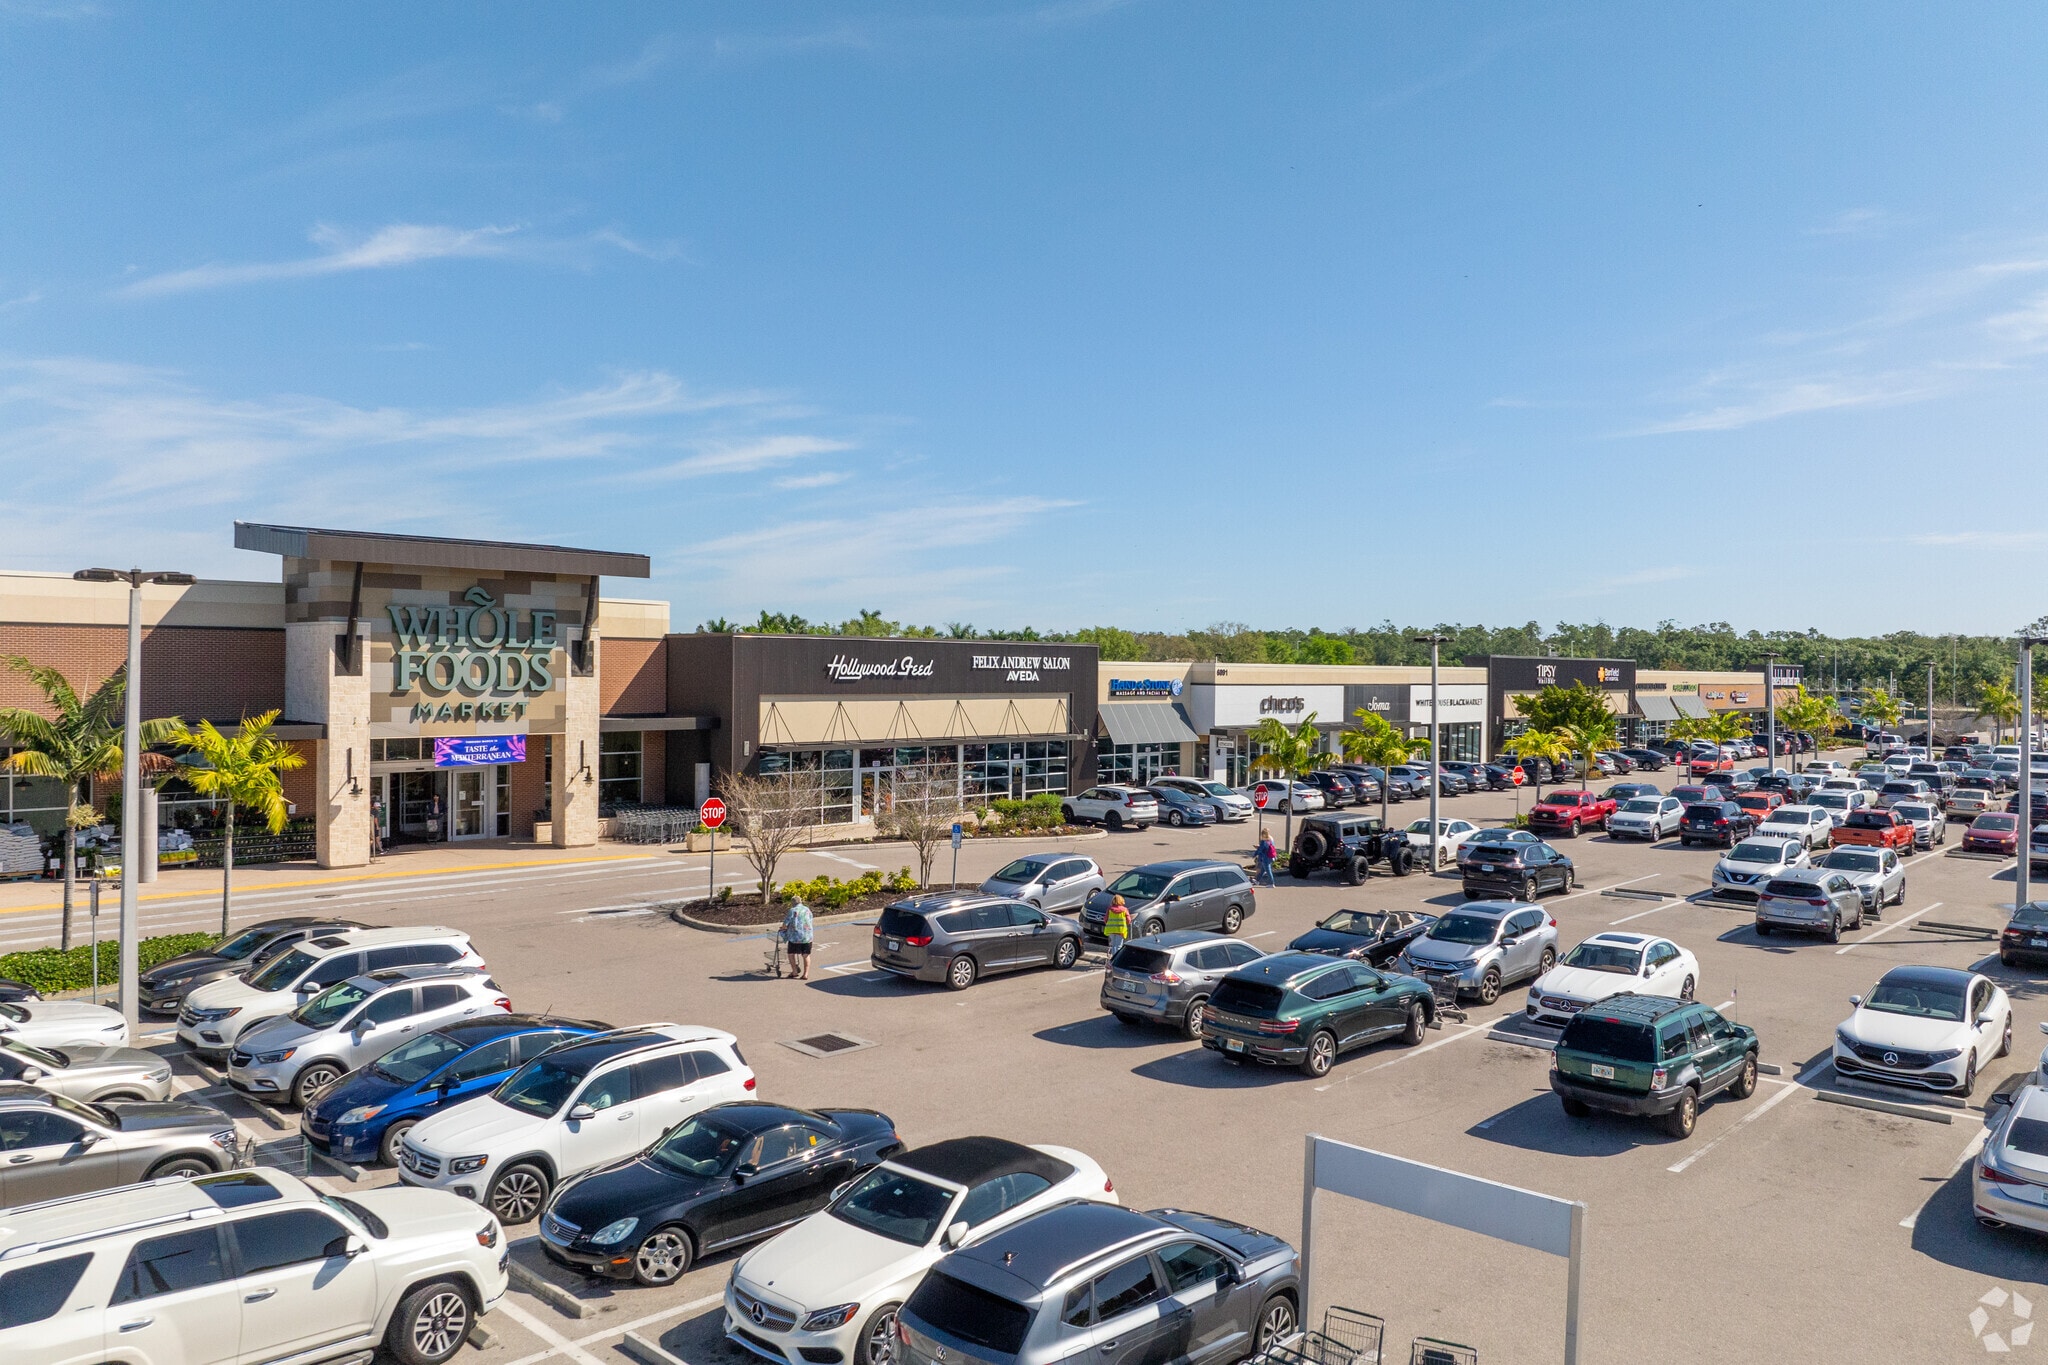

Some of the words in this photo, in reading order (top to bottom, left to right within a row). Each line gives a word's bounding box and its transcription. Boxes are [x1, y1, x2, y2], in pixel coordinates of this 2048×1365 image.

[385, 603, 557, 649] WHOLE
[827, 655, 897, 679] Hollywood
[898, 656, 934, 676] Feed
[972, 655, 1000, 669] FELIX
[1000, 656, 1041, 669] ANDREW
[1042, 656, 1071, 670] SALON
[397, 650, 553, 692] FOODS
[1006, 671, 1040, 681] AVEDA
[1536, 664, 1556, 678] TIPSY
[416, 701, 530, 717] MARKET
[1367, 696, 1391, 711] Soma
[464, 744, 488, 753] TASTE
[1255, 791, 1268, 801] STOP
[702, 807, 725, 819] STOP
